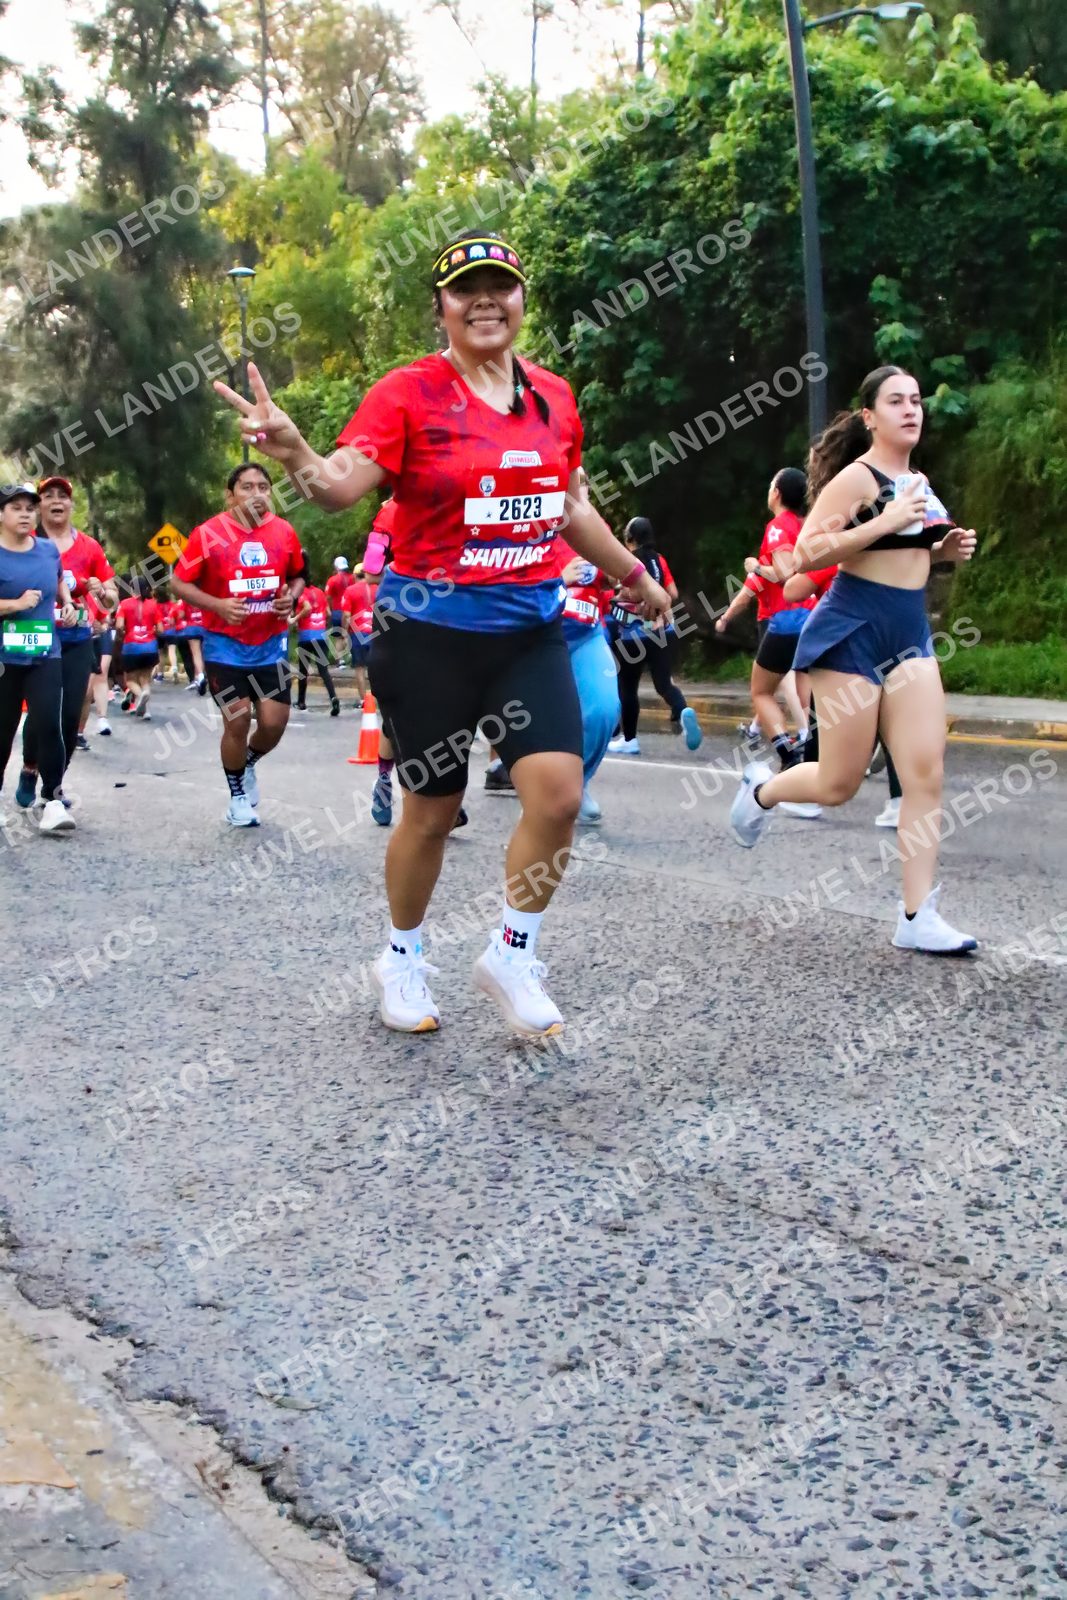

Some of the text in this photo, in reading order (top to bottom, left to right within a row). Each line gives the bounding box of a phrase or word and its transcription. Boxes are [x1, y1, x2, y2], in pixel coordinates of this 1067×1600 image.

[499, 496, 542, 521] 2623
[246, 578, 266, 590] 1652
[22, 633, 39, 645] 766
